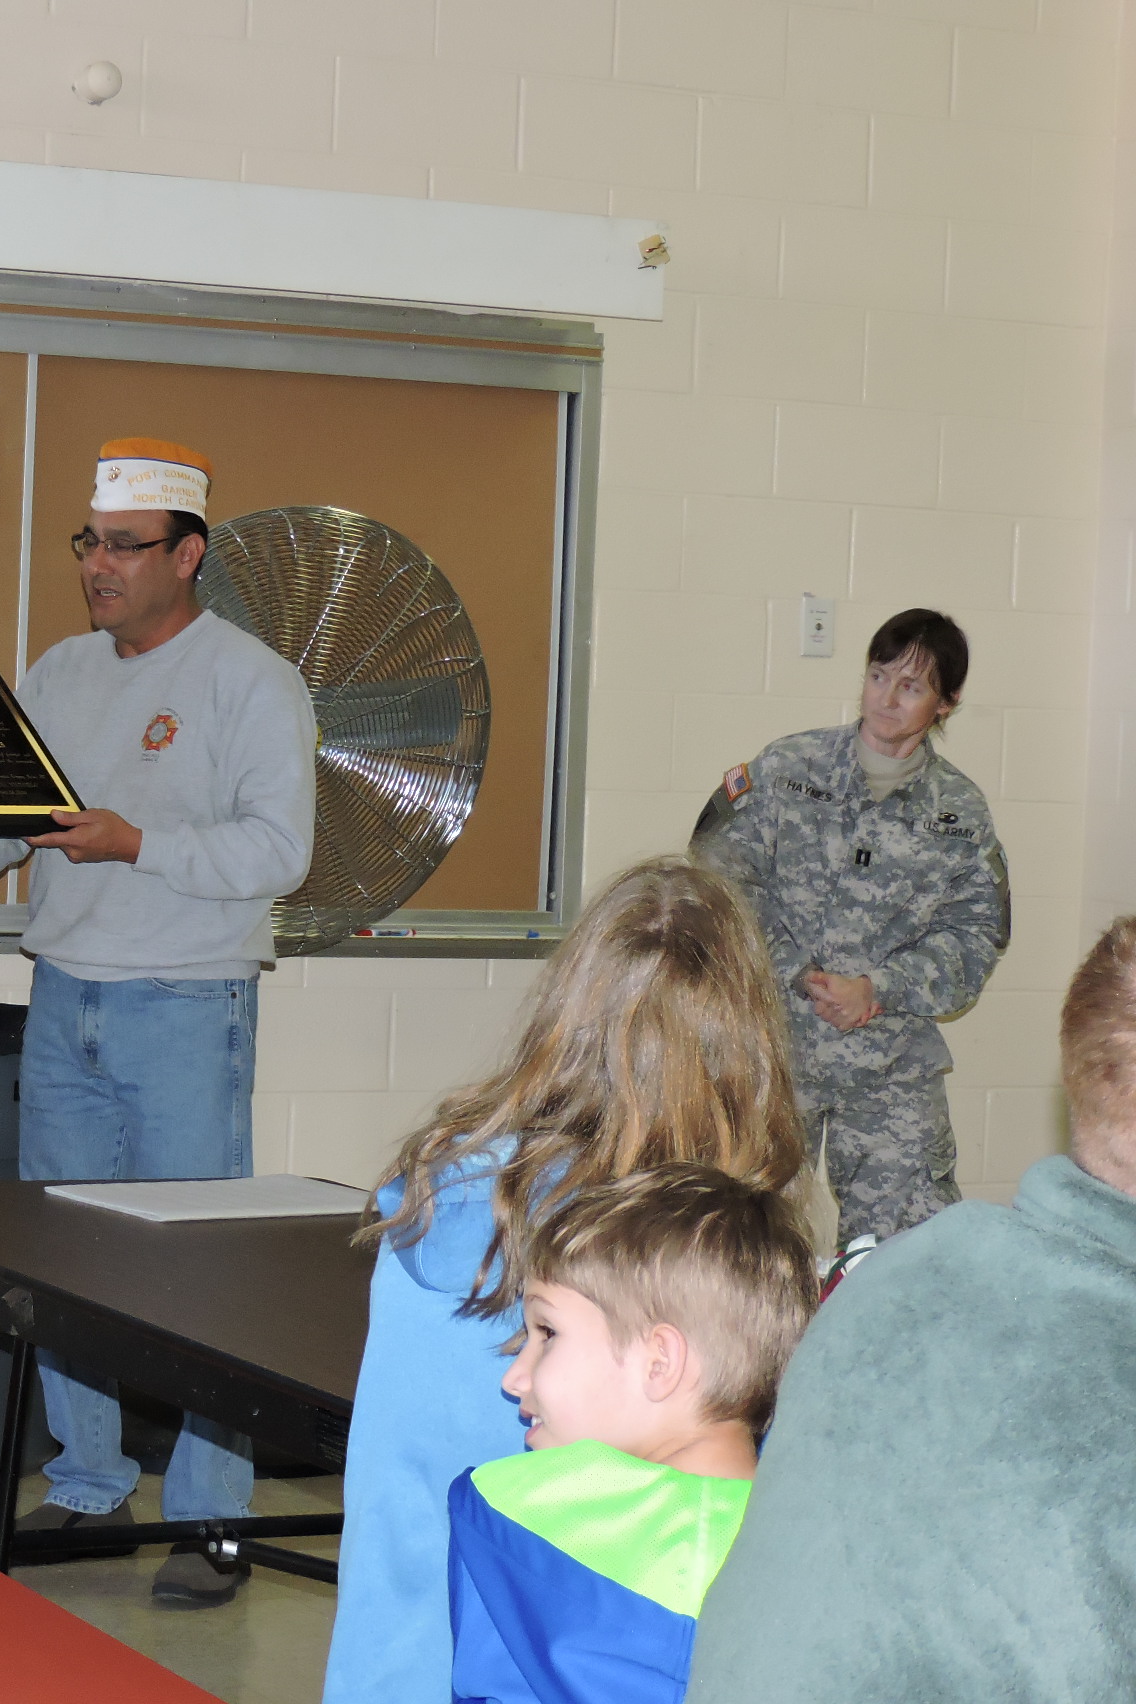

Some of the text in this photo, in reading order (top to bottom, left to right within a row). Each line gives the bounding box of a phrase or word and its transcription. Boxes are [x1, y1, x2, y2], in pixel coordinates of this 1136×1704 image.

[127, 469, 158, 488] POST
[132, 493, 172, 504] NORTH
[786, 780, 832, 802] HAYNES
[944, 827, 975, 839] ARMY
